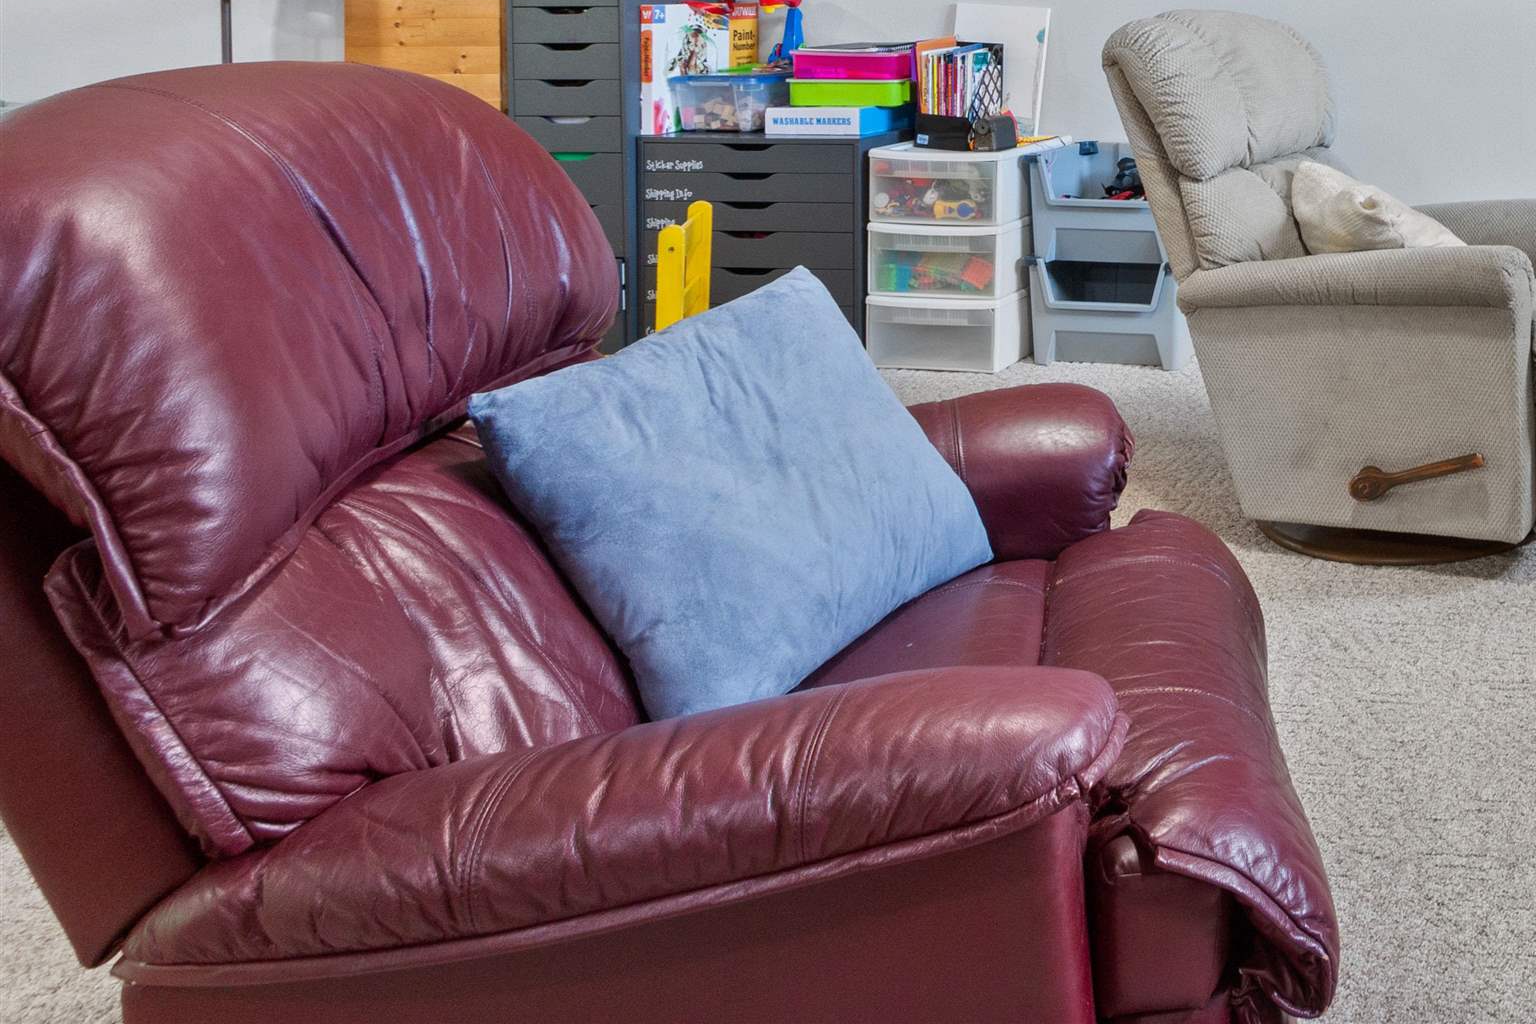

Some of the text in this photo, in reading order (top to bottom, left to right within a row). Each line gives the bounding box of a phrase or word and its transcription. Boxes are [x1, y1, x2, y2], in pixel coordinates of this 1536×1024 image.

[654, 9, 665, 20] 7+
[733, 29, 756, 41] Paint-
[772, 117, 852, 126] WASHABLE MARKERS
[646, 159, 704, 172] Sticker Supplies
[645, 188, 693, 201] Shipping Info
